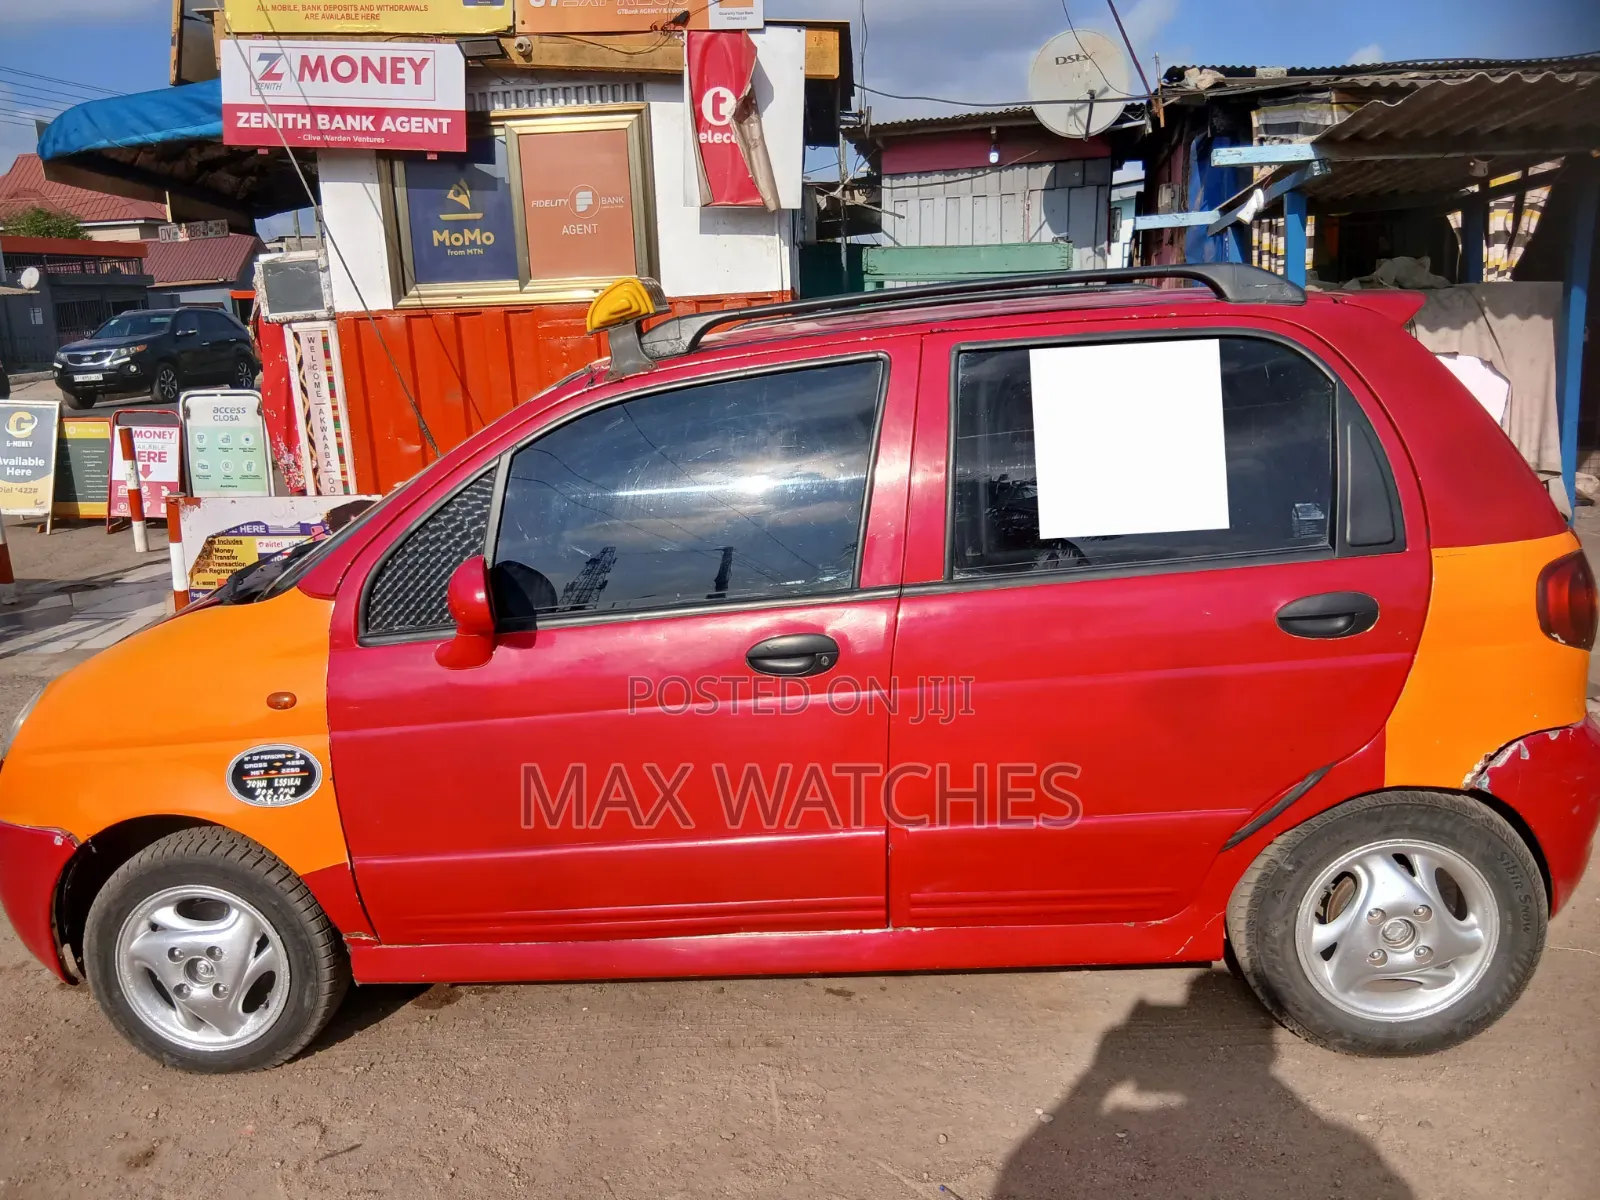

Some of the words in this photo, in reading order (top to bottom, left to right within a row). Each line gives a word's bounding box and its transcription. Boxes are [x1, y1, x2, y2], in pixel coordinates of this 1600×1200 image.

[256, 4, 270, 12] ALL
[271, 4, 300, 13] MOBILE,
[301, 4, 322, 12] BANK
[323, 4, 359, 12] DEPOSITS
[359, 4, 375, 12] AND
[376, 4, 429, 12] WITHDRAWALS
[639, 7, 663, 15] AGENCY
[304, 12, 320, 20] ARE
[320, 12, 360, 20] AVAILABLE
[361, 12, 381, 20] HERE
[298, 54, 431, 86] MONEY
[255, 82, 282, 91] ZENITH
[236, 111, 312, 130] ZENITH
[316, 113, 377, 132] BANK
[380, 115, 452, 135] AGENT
[322, 134, 351, 143] Warden
[352, 135, 385, 144] Ventures
[531, 198, 569, 208] FIDELITY
[601, 196, 625, 205] BANK
[562, 223, 599, 236] AGENT
[432, 228, 495, 247] MoMo
[447, 248, 466, 256] from
[466, 248, 484, 256] MTN
[306, 336, 323, 398] WELCOME
[212, 406, 247, 415] access
[212, 414, 240, 422] CLOSA
[133, 429, 175, 440] MONEY
[318, 408, 333, 468] AKWAABA
[137, 450, 168, 463] ERE
[6, 467, 33, 477] Here
[239, 524, 267, 534] HERE
[217, 538, 244, 546] Includes
[264, 540, 284, 548] airtel
[214, 547, 235, 556] Money
[208, 567, 239, 576] Registrati
